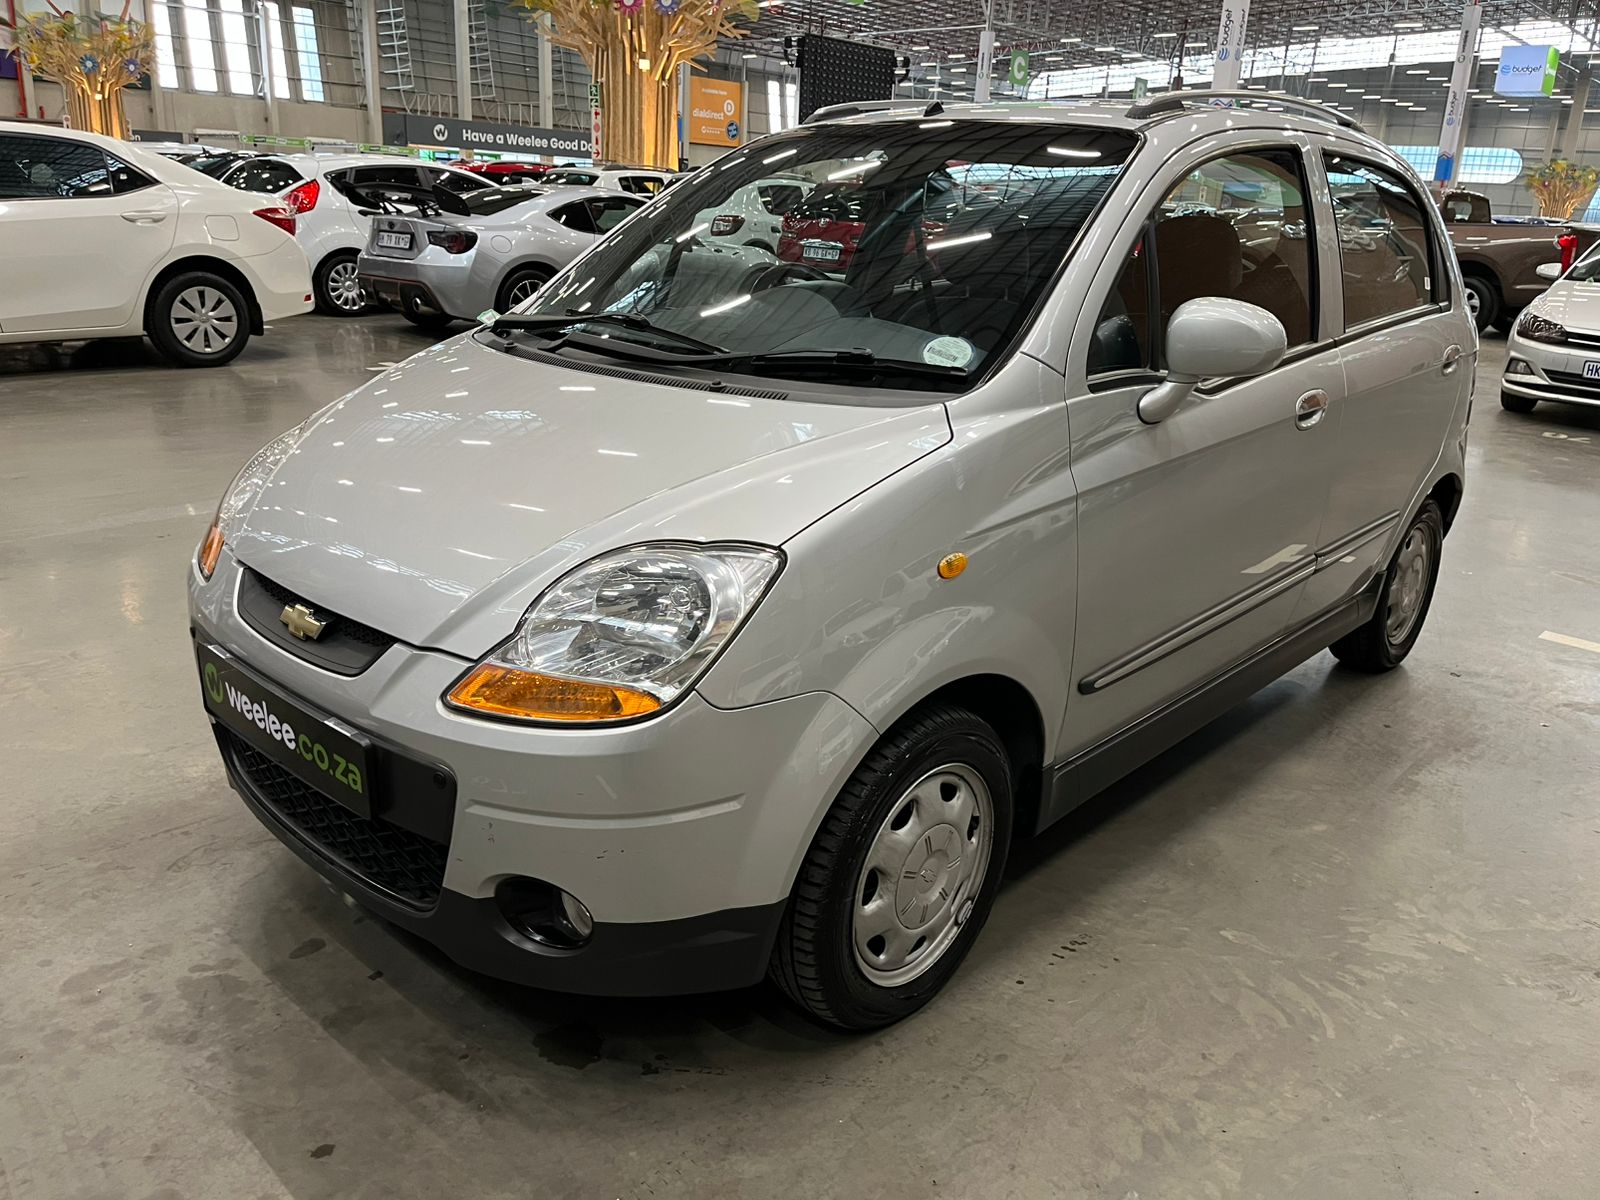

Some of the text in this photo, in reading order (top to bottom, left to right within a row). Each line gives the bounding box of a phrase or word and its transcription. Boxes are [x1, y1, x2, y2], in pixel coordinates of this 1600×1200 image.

[1220, 8, 1234, 46] budget
[1013, 56, 1026, 80] C
[1511, 63, 1542, 76] budget
[462, 129, 494, 144] Have
[495, 135, 504, 144] a
[506, 133, 548, 148] Weelee
[550, 138, 578, 151] Good
[225, 681, 363, 794] weelee.co.za
